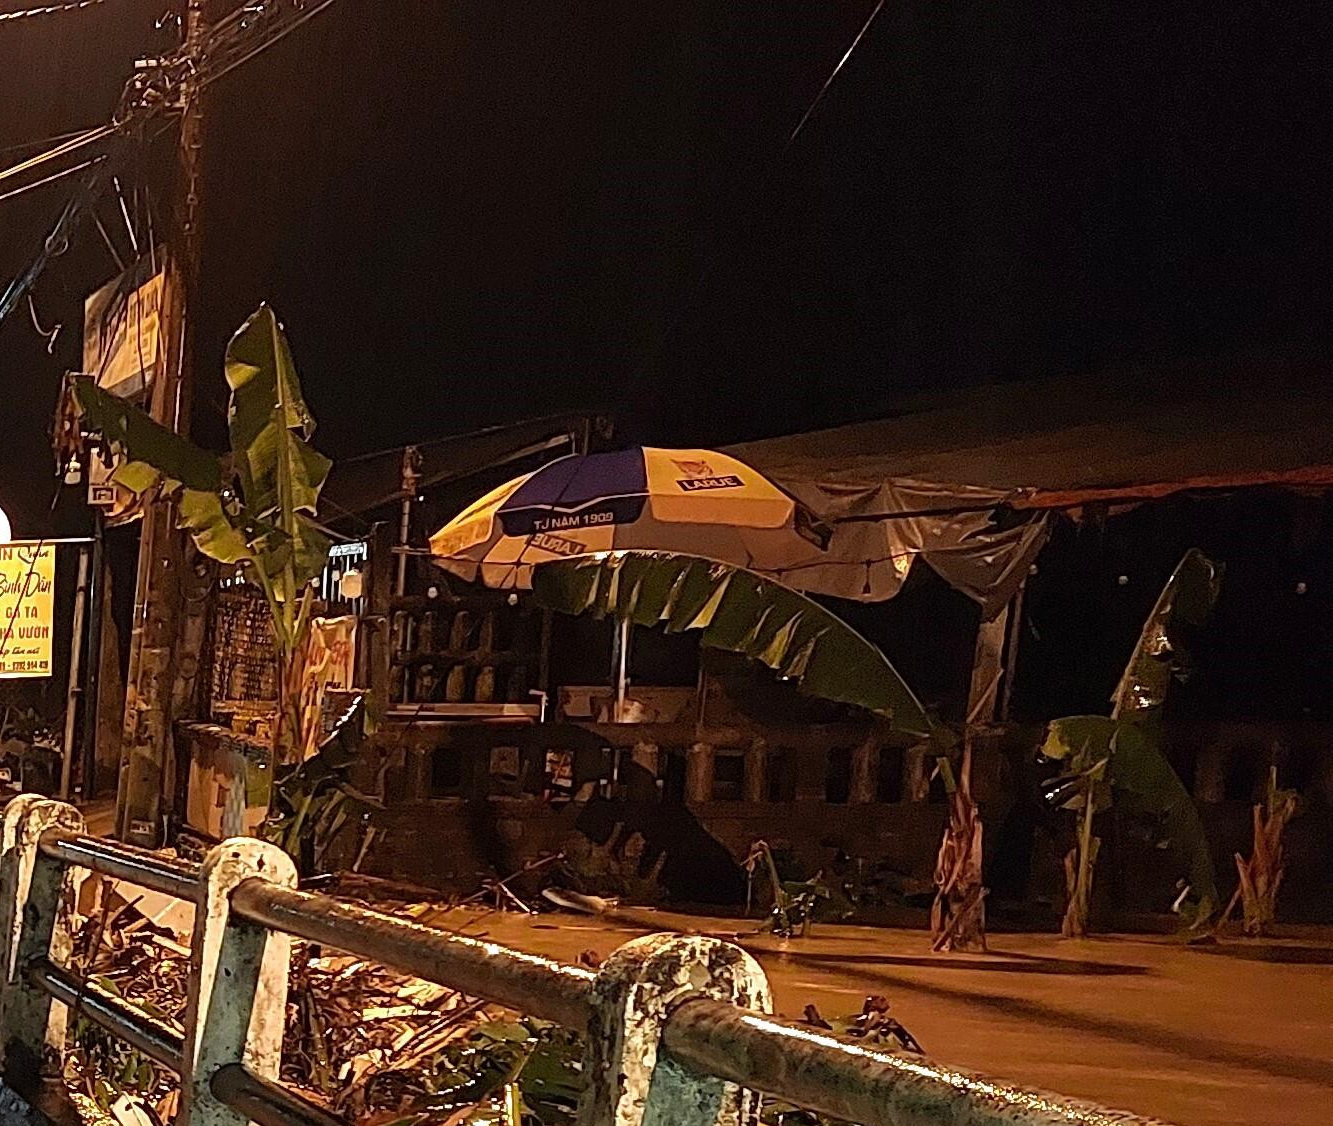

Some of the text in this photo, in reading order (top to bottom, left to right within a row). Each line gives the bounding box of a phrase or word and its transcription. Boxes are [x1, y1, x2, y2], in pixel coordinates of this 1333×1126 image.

[683, 477, 737, 490] LARUE
[582, 512, 615, 525] 1909
[24, 606, 38, 619] TA
